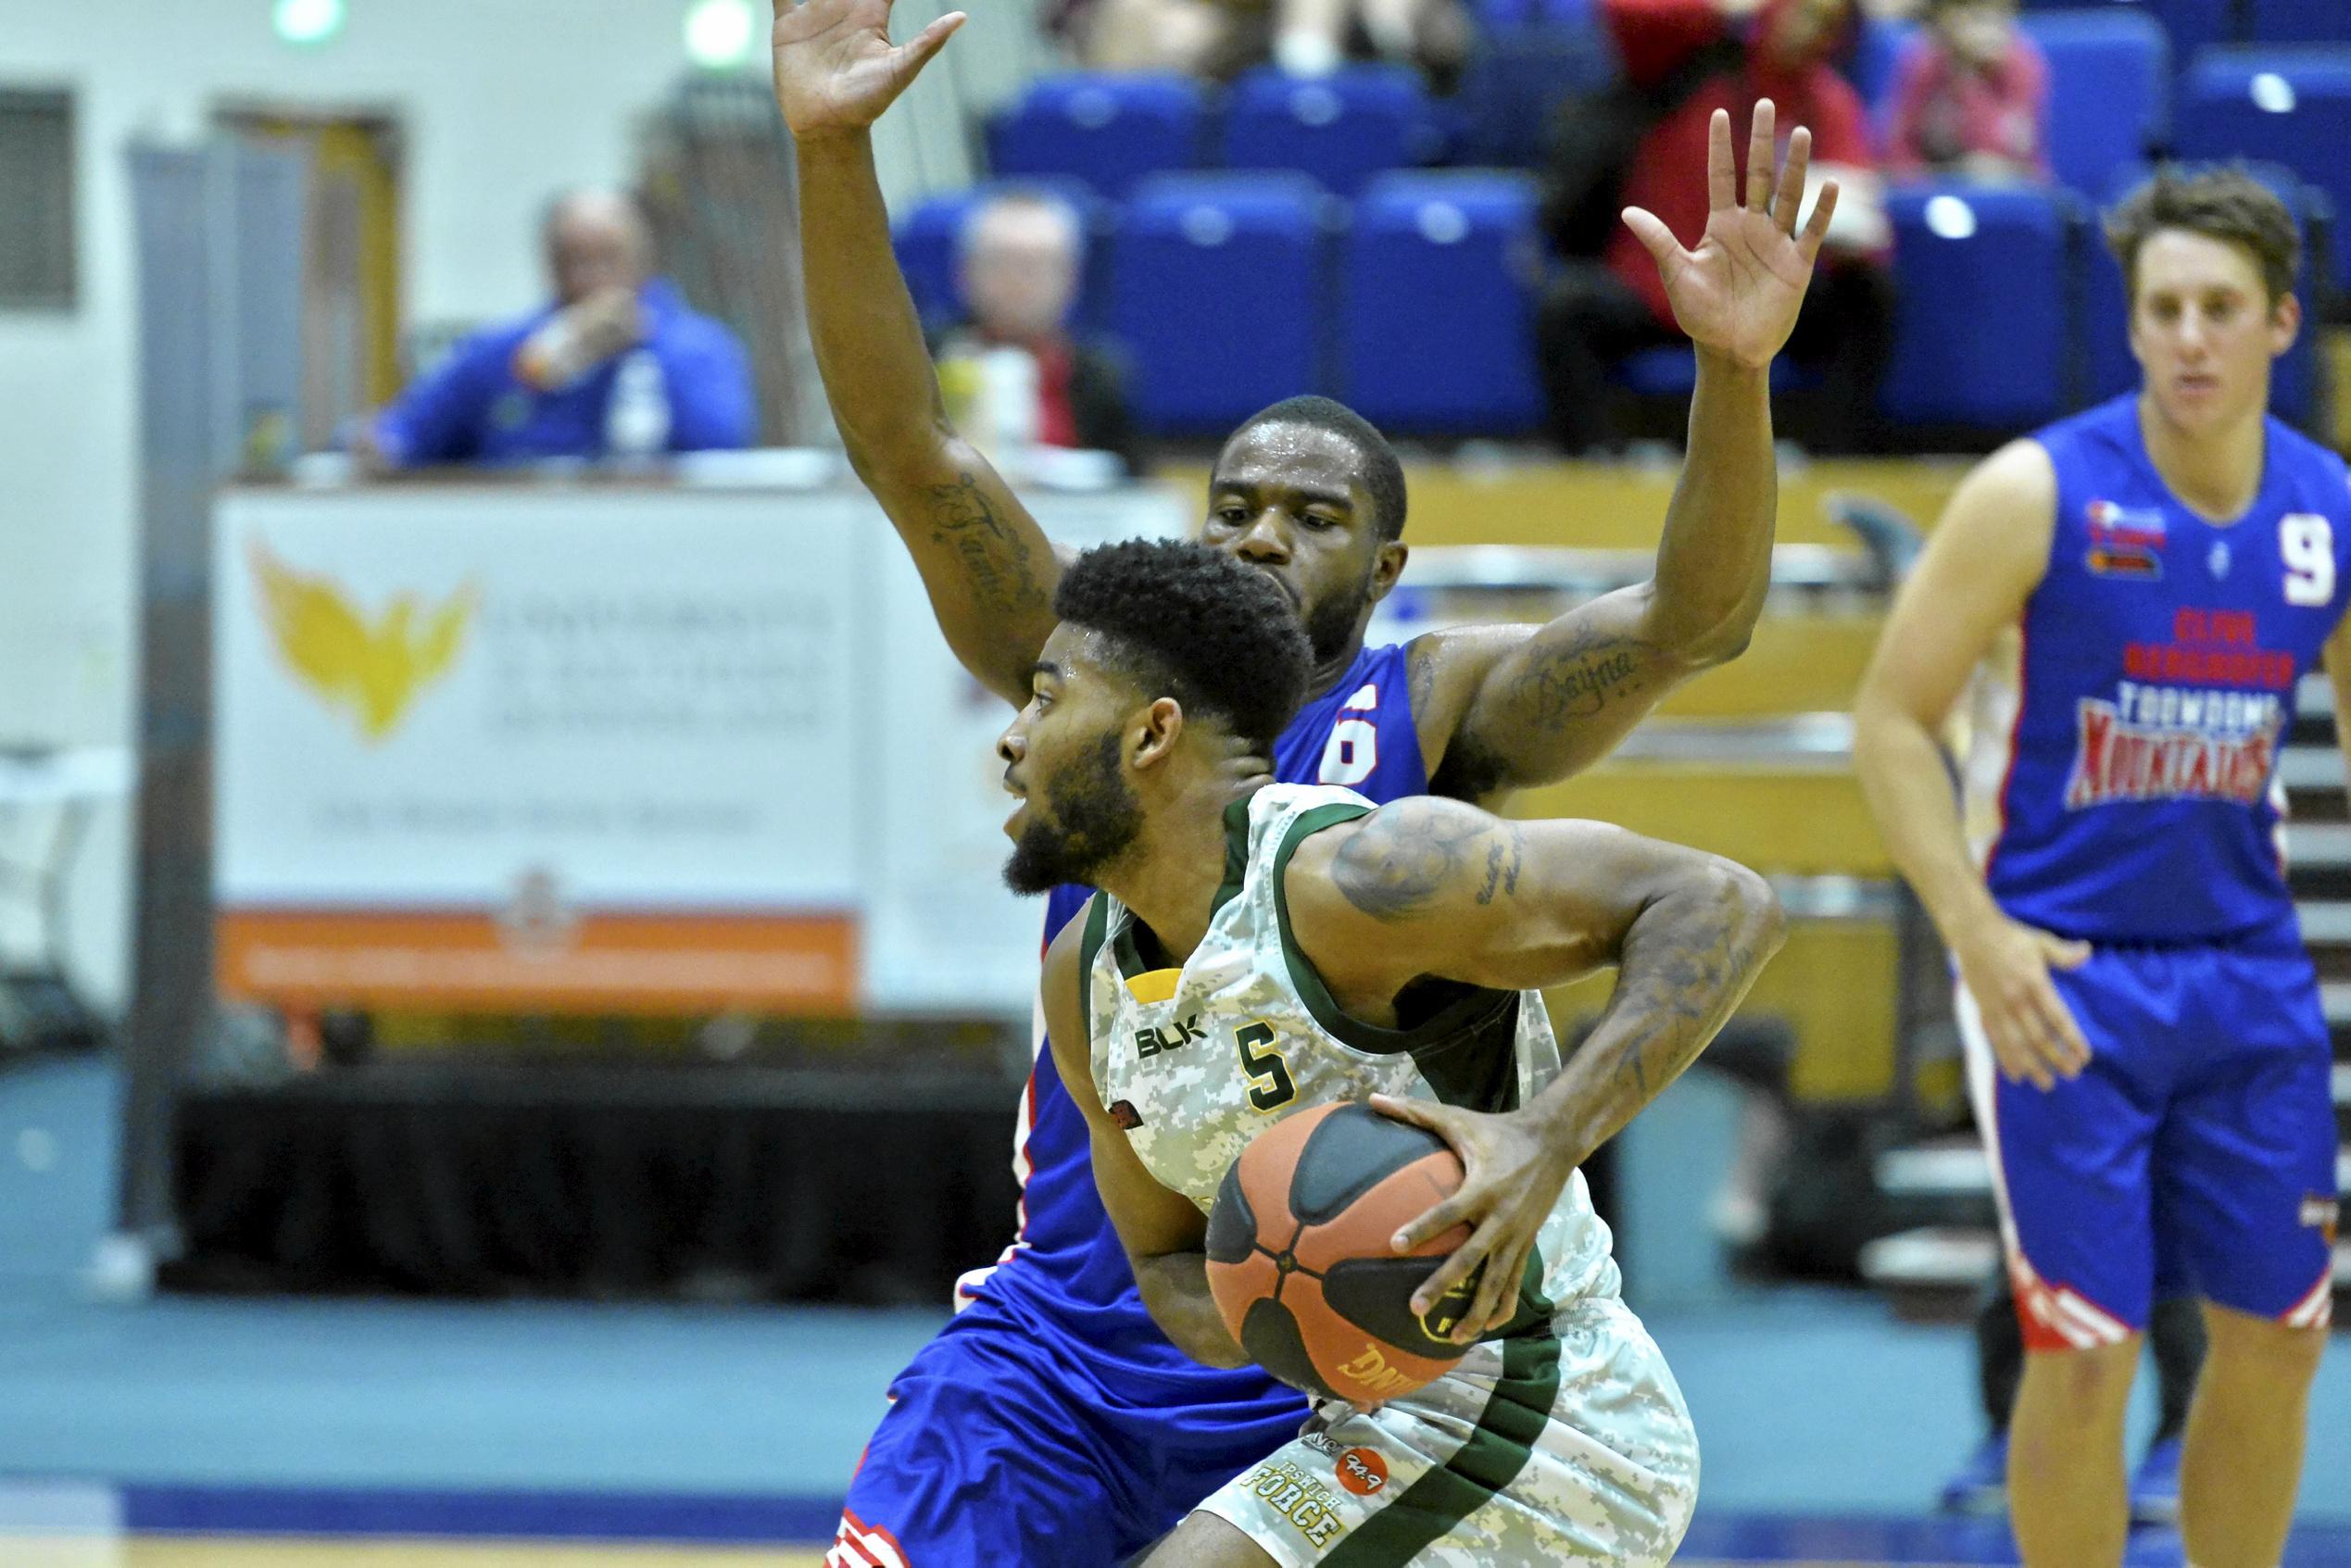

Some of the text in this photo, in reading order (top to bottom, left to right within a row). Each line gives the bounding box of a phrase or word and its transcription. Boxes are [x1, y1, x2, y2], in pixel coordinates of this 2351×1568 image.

[2279, 513, 2336, 607] 9
[1318, 683, 1378, 786] 6
[1135, 1013, 1208, 1060] BLK
[1276, 1461, 1342, 1512] IPSWICH
[1346, 1453, 1384, 1490] 94.9
[1239, 1466, 1342, 1548] FORCE
